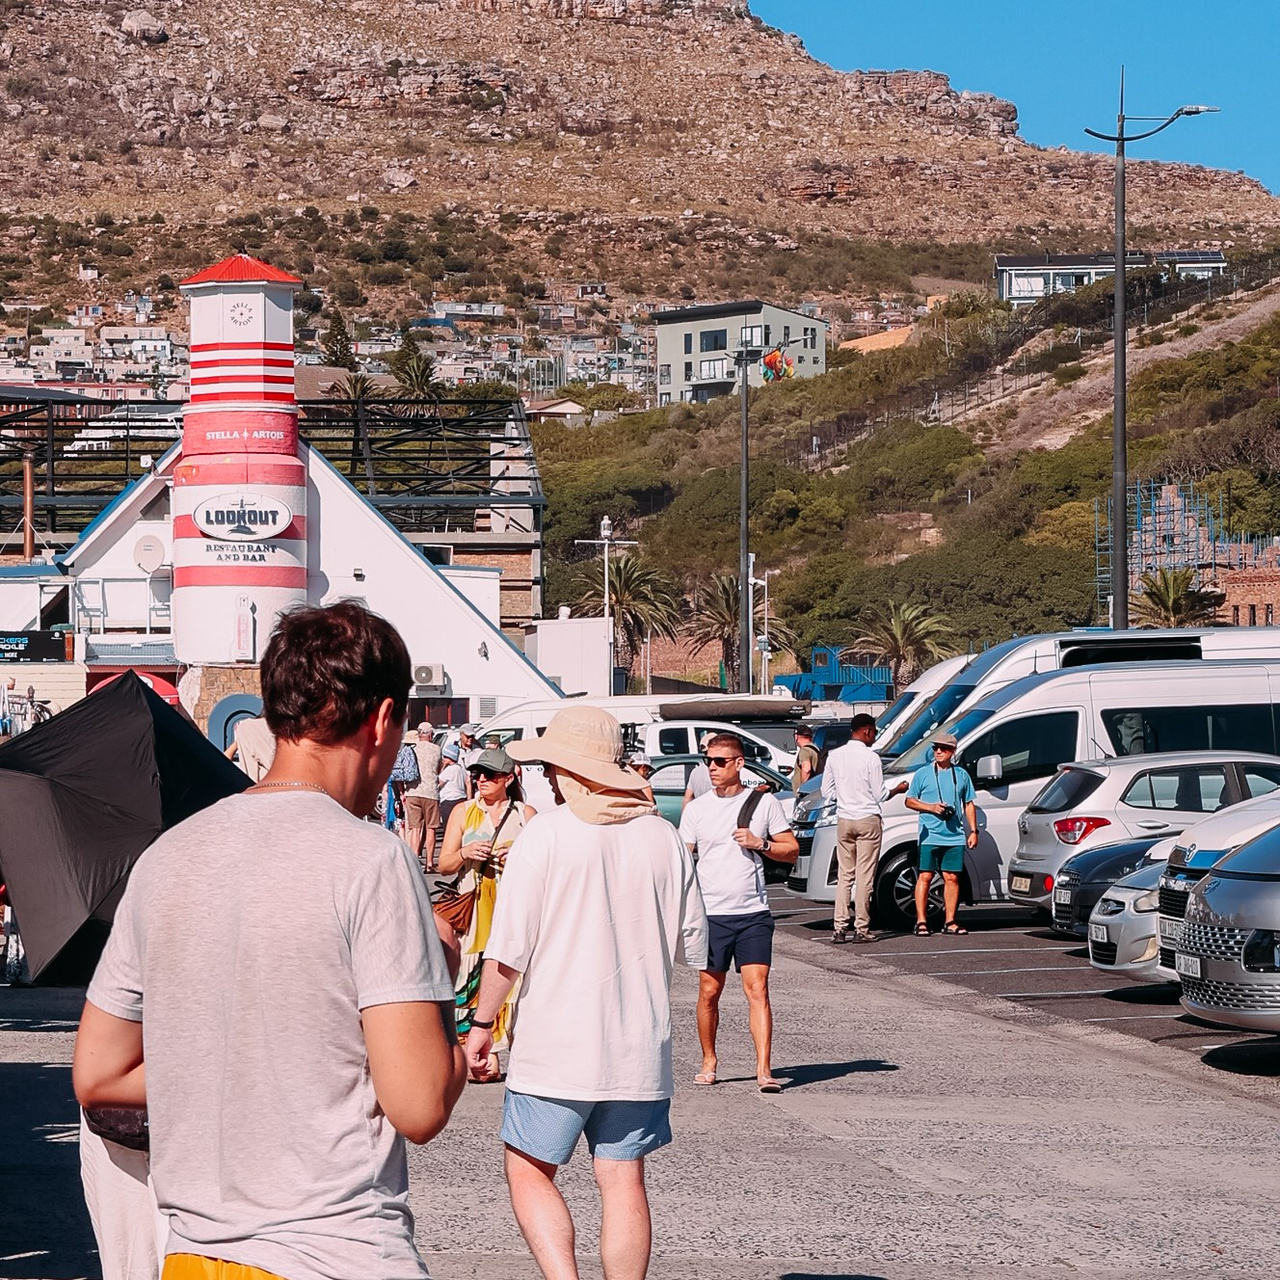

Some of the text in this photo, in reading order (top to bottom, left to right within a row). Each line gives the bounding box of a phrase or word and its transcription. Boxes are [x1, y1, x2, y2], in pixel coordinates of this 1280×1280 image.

[206, 430, 284, 440] STELLA ARTOIS
[205, 509, 279, 526] LOOKOUT
[205, 543, 278, 554] RESTAURANT
[216, 553, 267, 562] AND BAR
